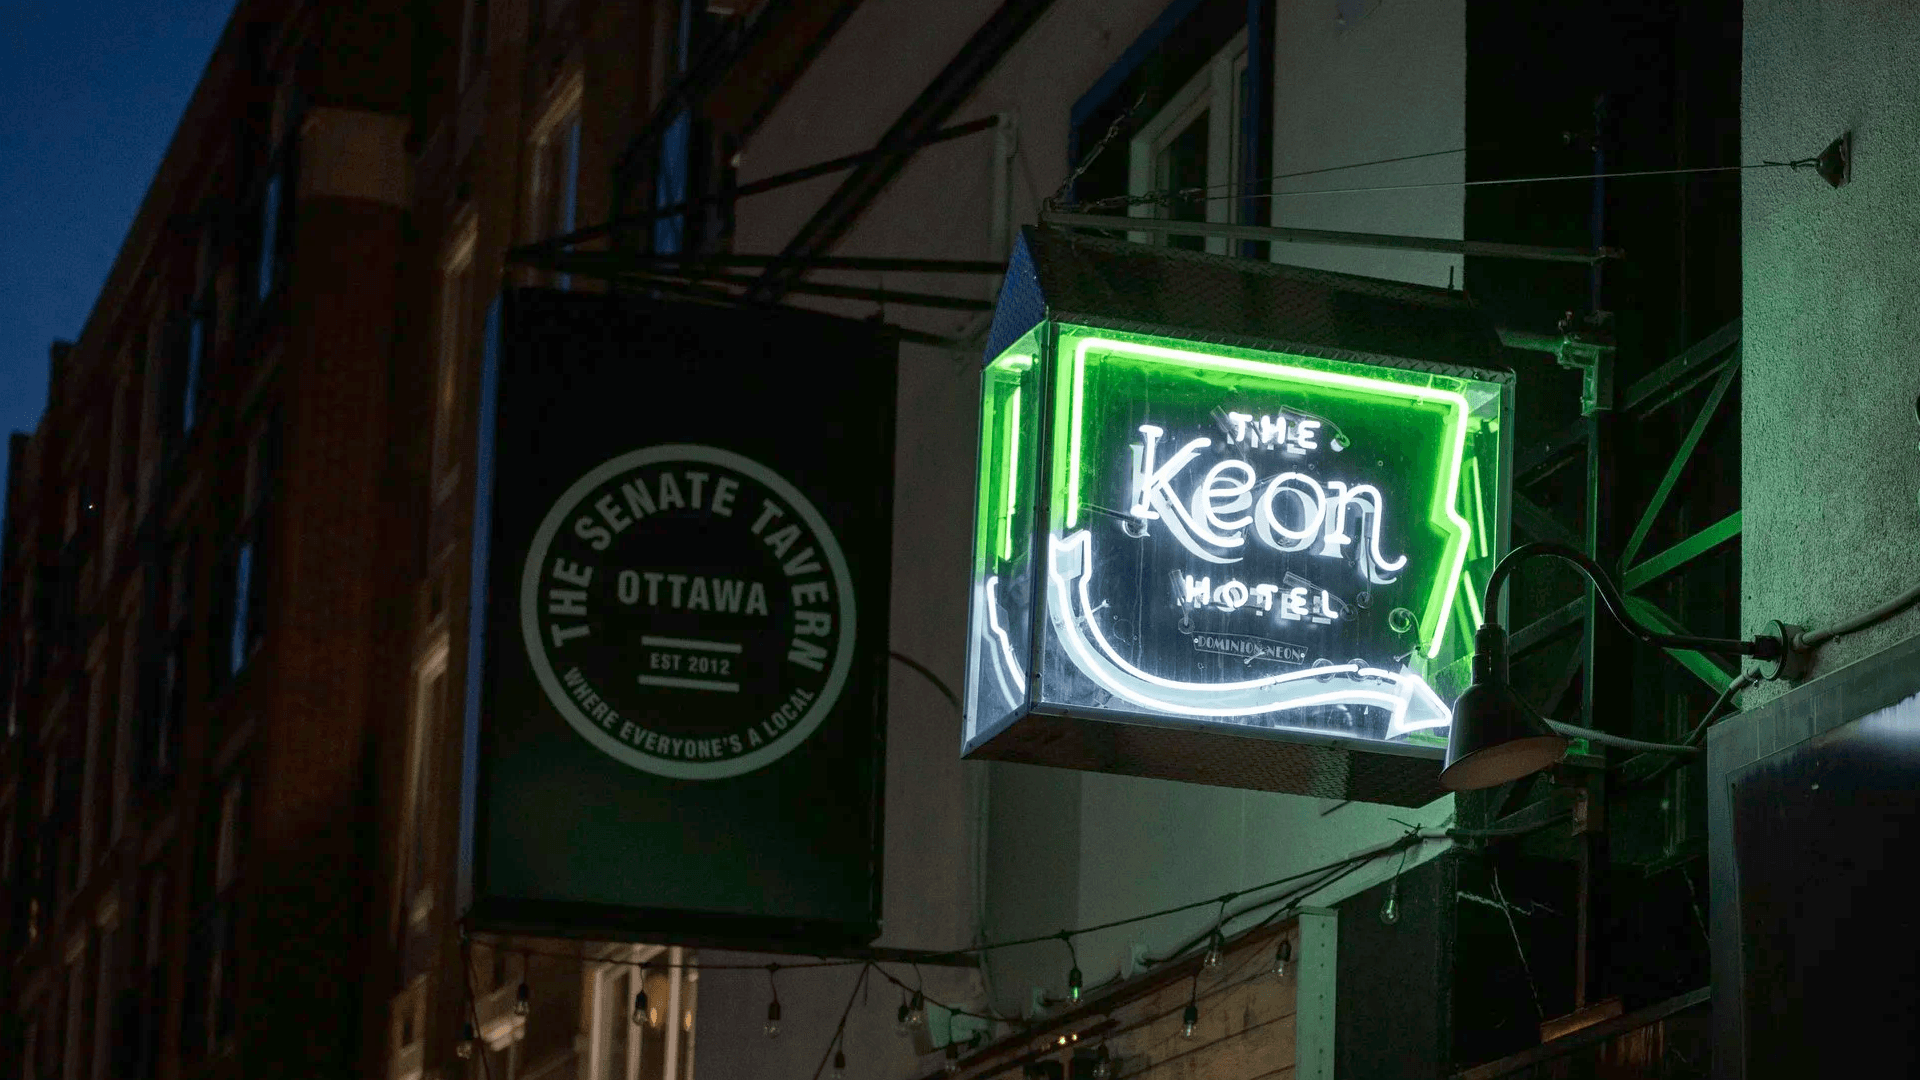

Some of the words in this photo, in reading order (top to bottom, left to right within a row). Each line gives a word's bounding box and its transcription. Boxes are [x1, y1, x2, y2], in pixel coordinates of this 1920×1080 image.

[1227, 411, 1321, 453] THE
[1129, 424, 1408, 585] Keon
[549, 557, 594, 648] THE
[574, 471, 740, 551] SENATE
[751, 498, 832, 672] TAVERN
[617, 570, 769, 616] OTTAWA
[1180, 574, 1339, 623] HOTEL
[650, 652, 683, 671] EST
[687, 654, 731, 676] 2012
[563, 666, 620, 729] WHERE
[619, 718, 744, 760] EVERYONE'S
[748, 726, 764, 748] A
[760, 687, 816, 738] LOCAL
